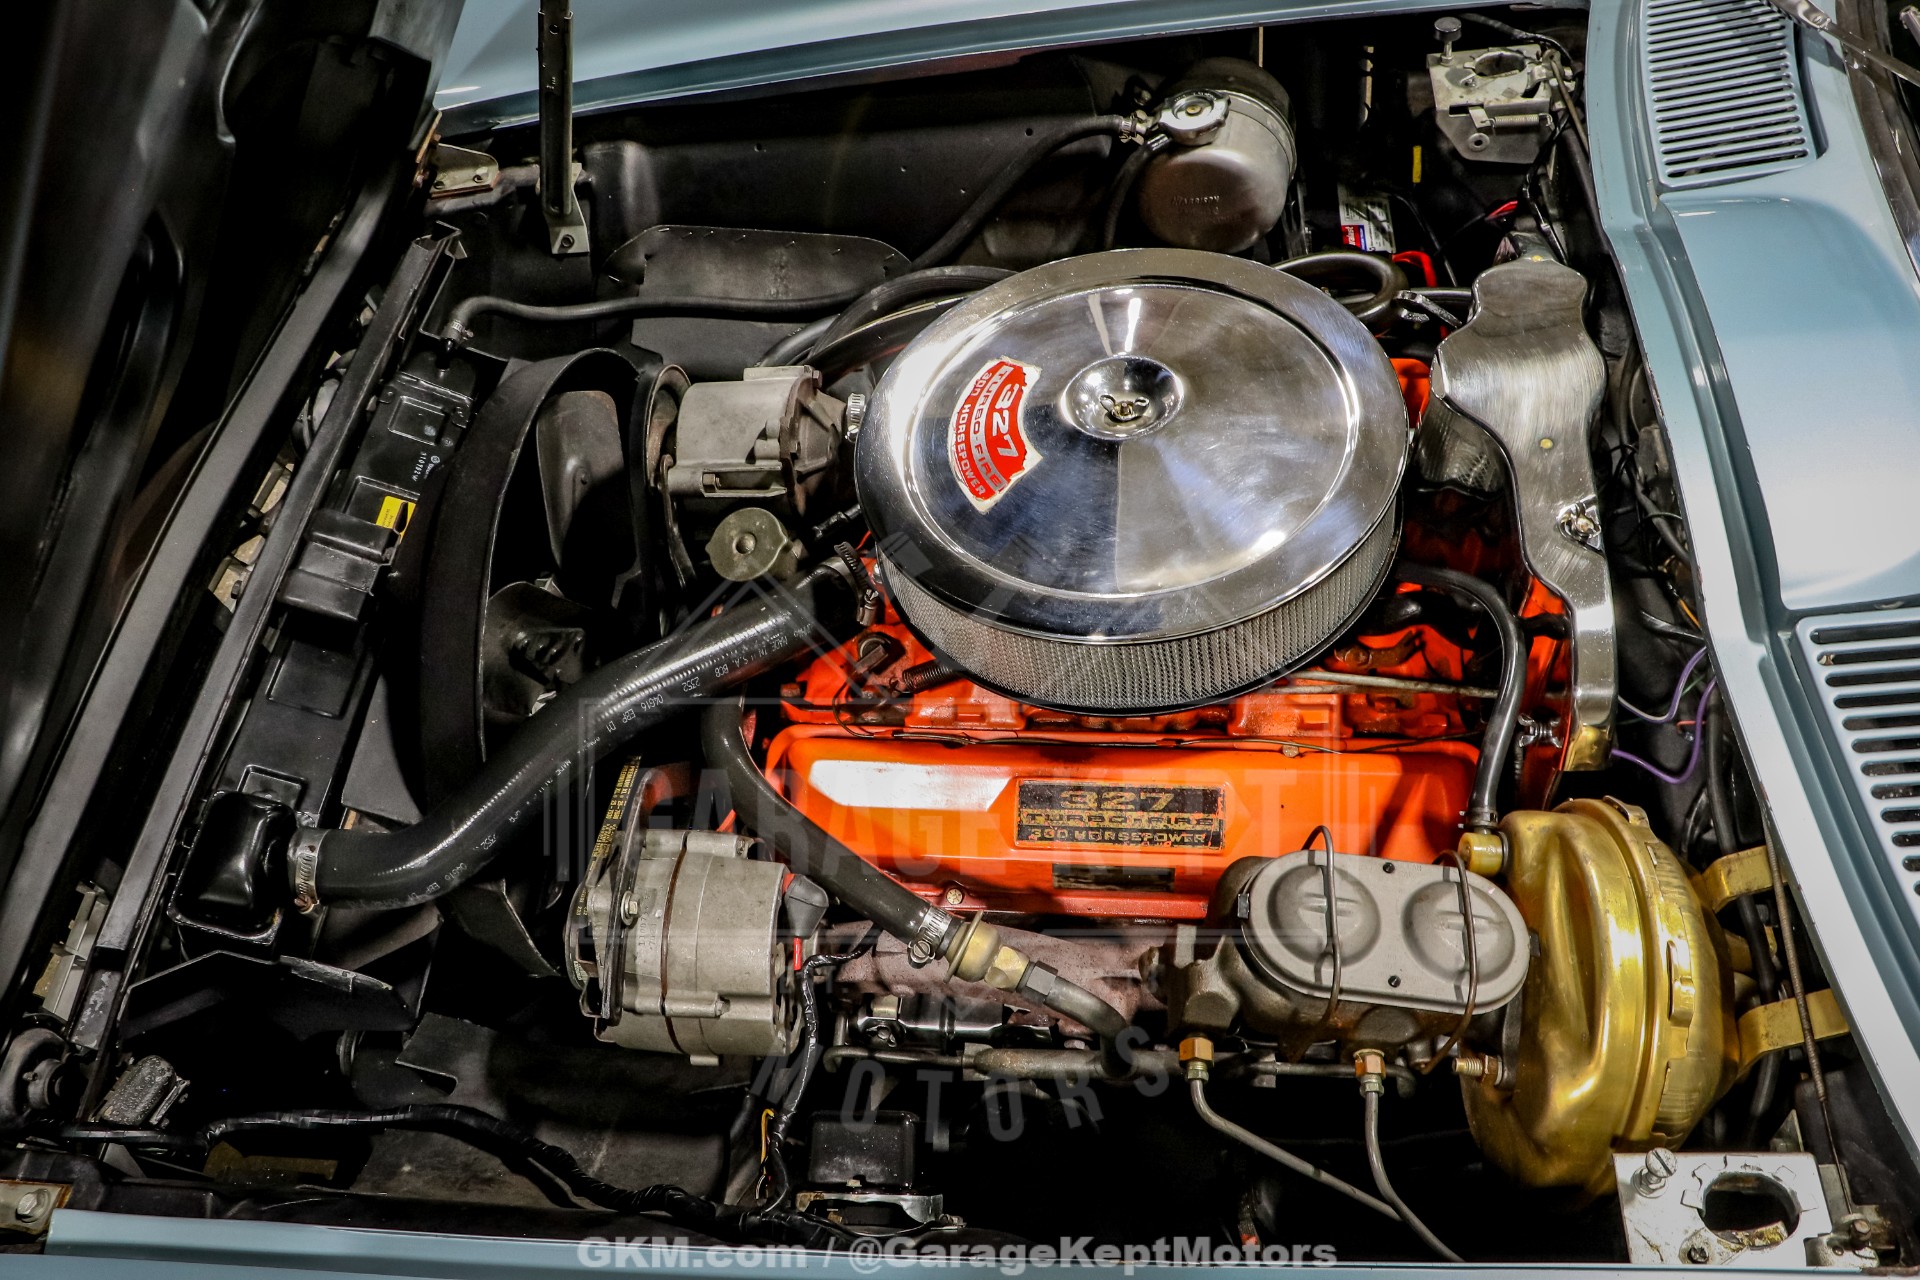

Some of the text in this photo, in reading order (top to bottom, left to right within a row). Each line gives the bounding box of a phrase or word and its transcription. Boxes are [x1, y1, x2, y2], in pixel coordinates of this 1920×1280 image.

[972, 368, 1009, 487] TURBO-FIRE
[991, 383, 1020, 458] 327
[955, 403, 988, 496] HORSEPOWER
[681, 676, 701, 692] 2352
[1060, 790, 1176, 812] 327
[1030, 828, 1207, 844] 300 HORSEPOWER
